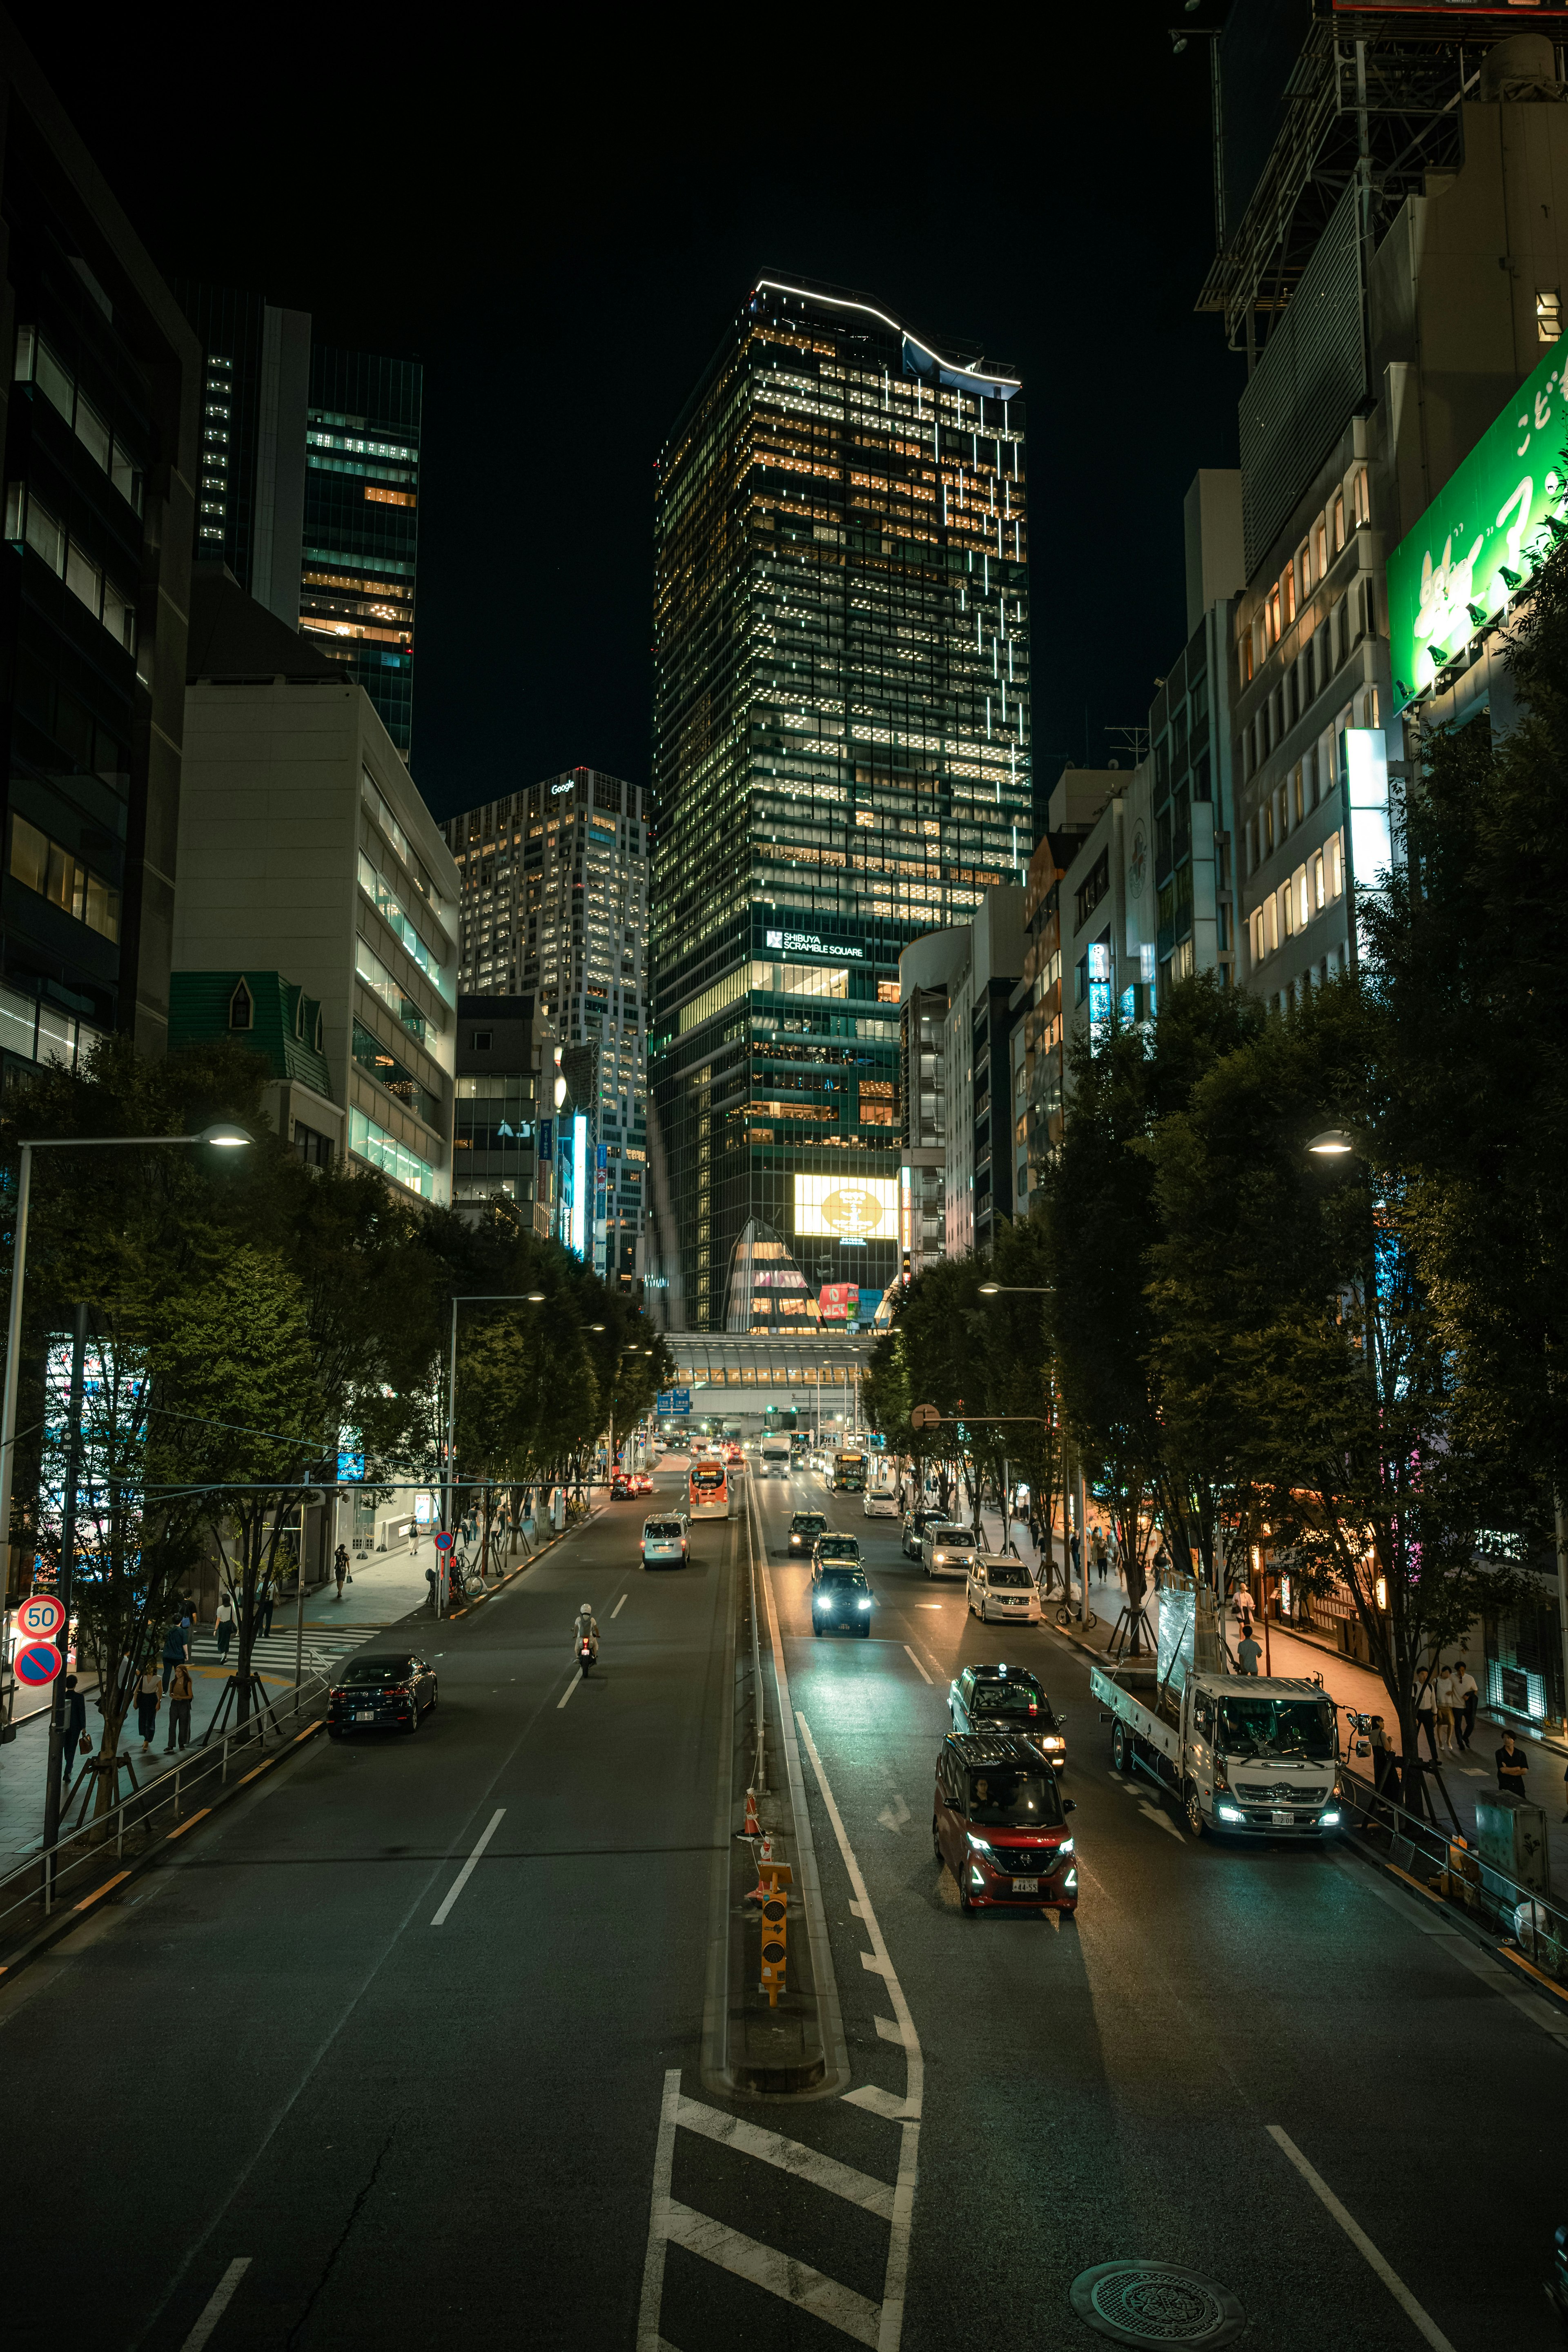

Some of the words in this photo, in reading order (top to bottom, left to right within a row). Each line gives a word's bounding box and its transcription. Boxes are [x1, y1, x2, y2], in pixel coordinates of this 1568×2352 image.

[552, 780, 574, 795] Google
[784, 932, 821, 944] SHIBUYA
[784, 942, 829, 953] SCRAMBLE
[829, 945, 863, 957] SQUARE
[28, 1608, 54, 1627] 50
